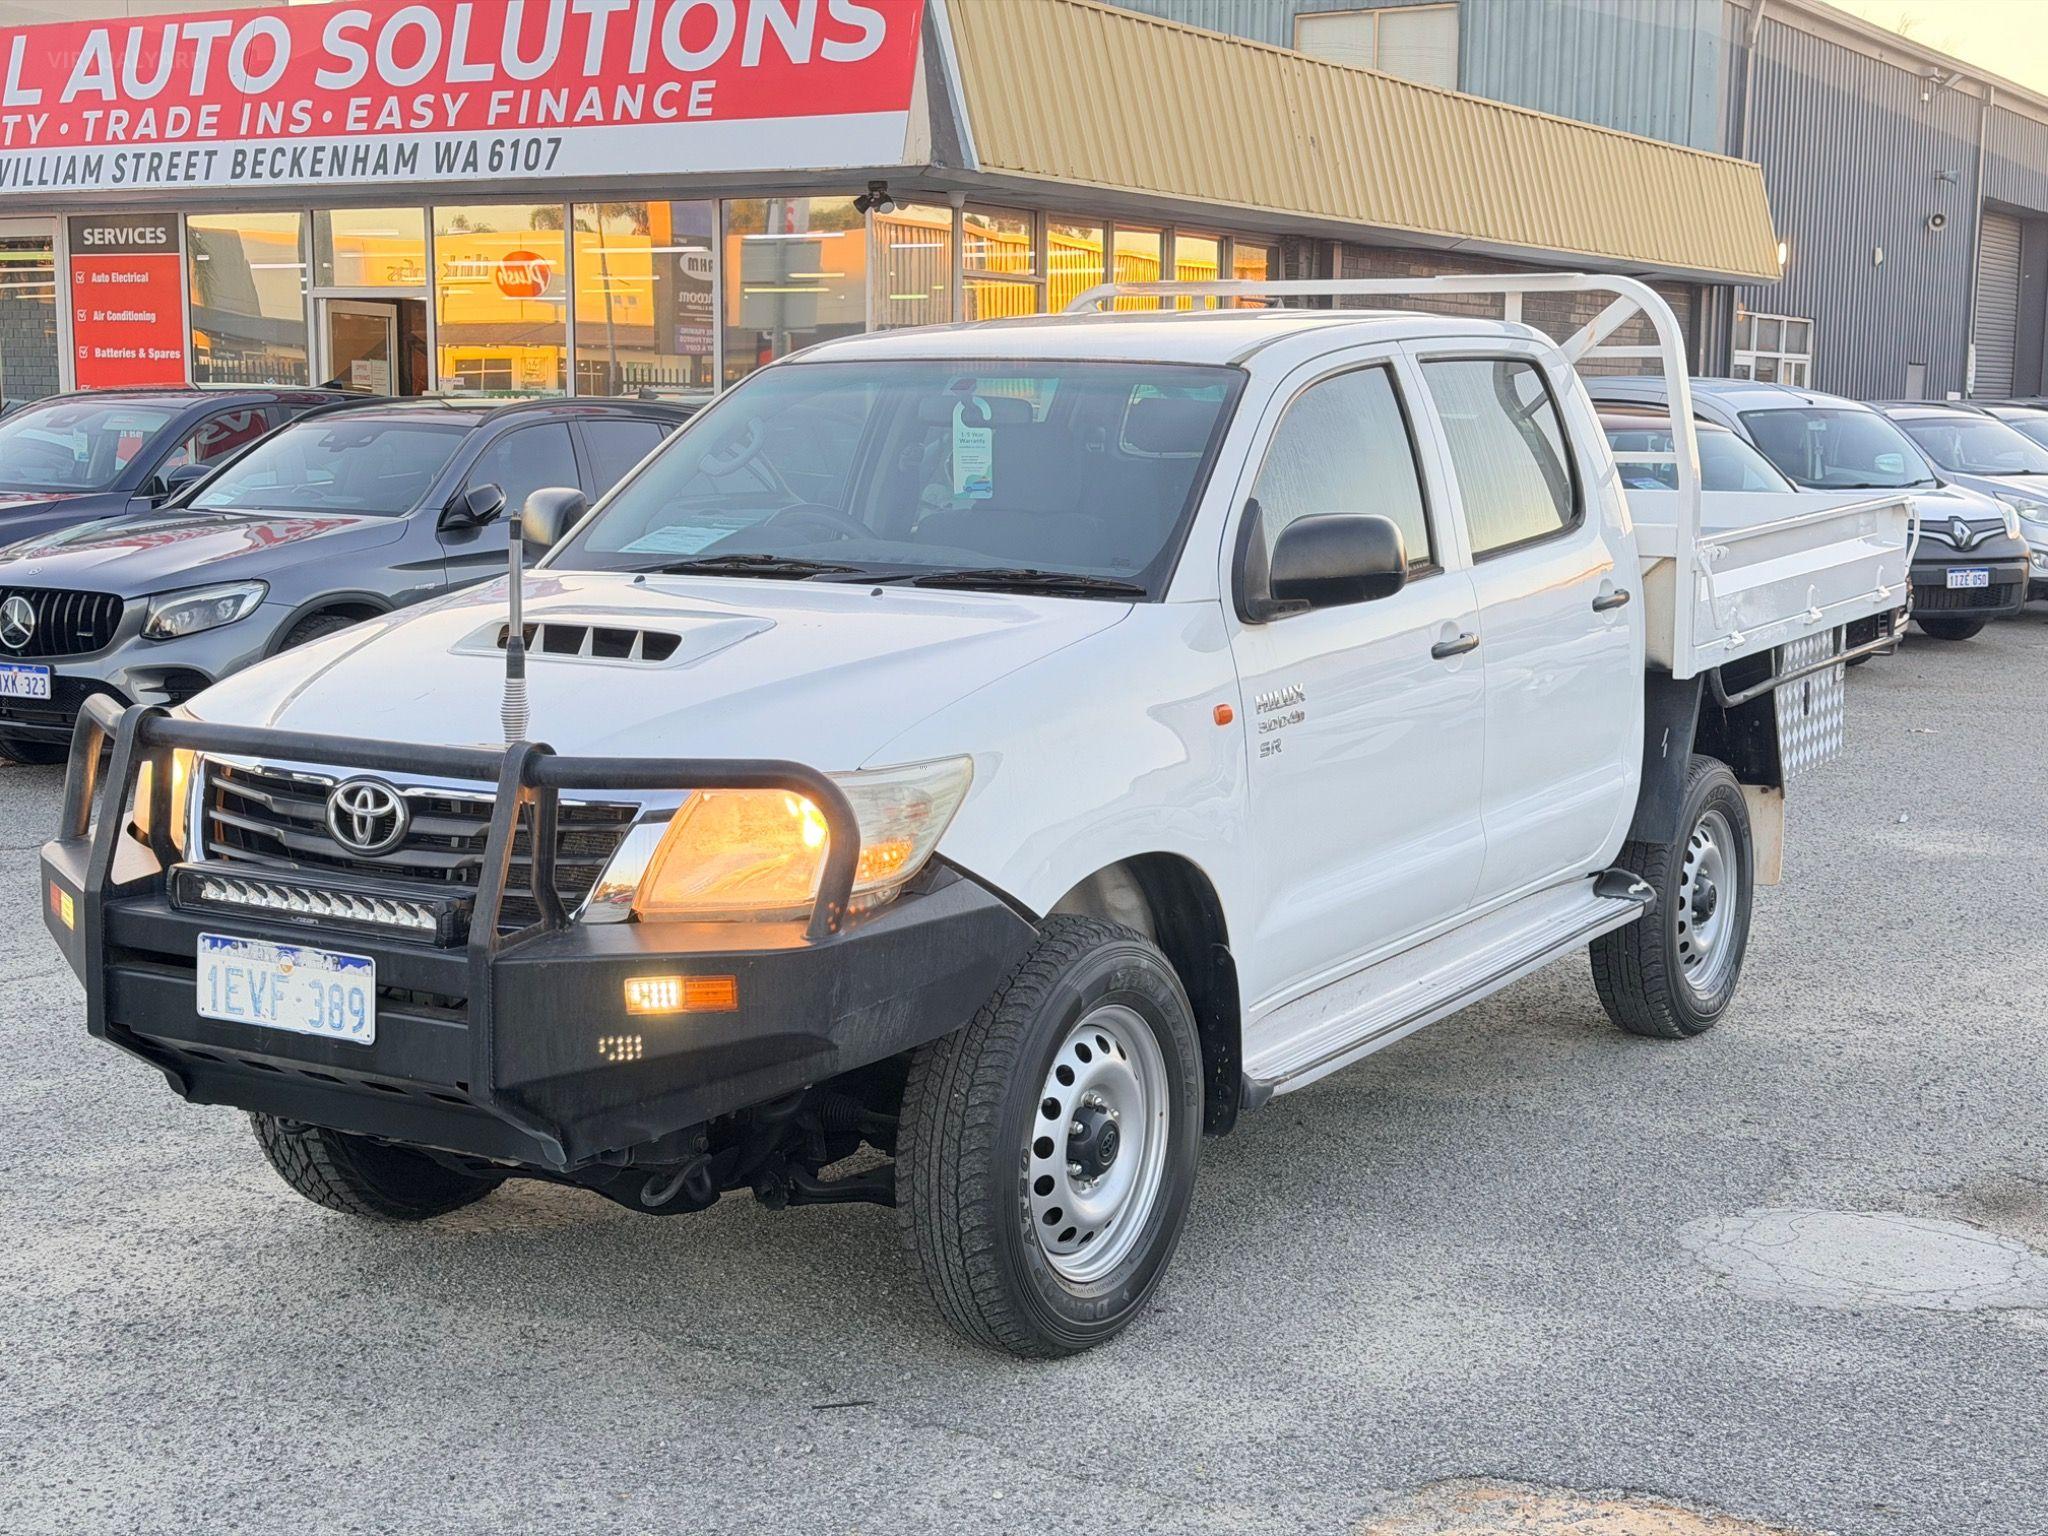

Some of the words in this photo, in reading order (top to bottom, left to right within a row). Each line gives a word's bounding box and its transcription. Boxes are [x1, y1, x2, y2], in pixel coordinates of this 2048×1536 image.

[3, 35, 43, 107] L
[59, 16, 292, 104] AUTO
[315, 0, 887, 90] SOLUTIONS
[2, 113, 50, 146] TY
[82, 104, 221, 142] TRADE
[240, 100, 313, 135] INS
[346, 92, 469, 131] EASY
[487, 80, 717, 126] FINANCE
[112, 150, 218, 184] STREET
[230, 142, 420, 180] BECKENHAM
[435, 140, 479, 173] WA
[488, 137, 562, 173] 6107
[83, 227, 167, 245] SERVICES
[91, 272, 110, 283] Auto
[111, 271, 149, 284] Electrical
[93, 310, 105, 321] Air
[106, 310, 156, 323] Conditioning
[94, 347, 137, 359] Batteries
[138, 348, 146, 359] &
[147, 347, 181, 360] Spares
[1259, 738, 1282, 758] SR
